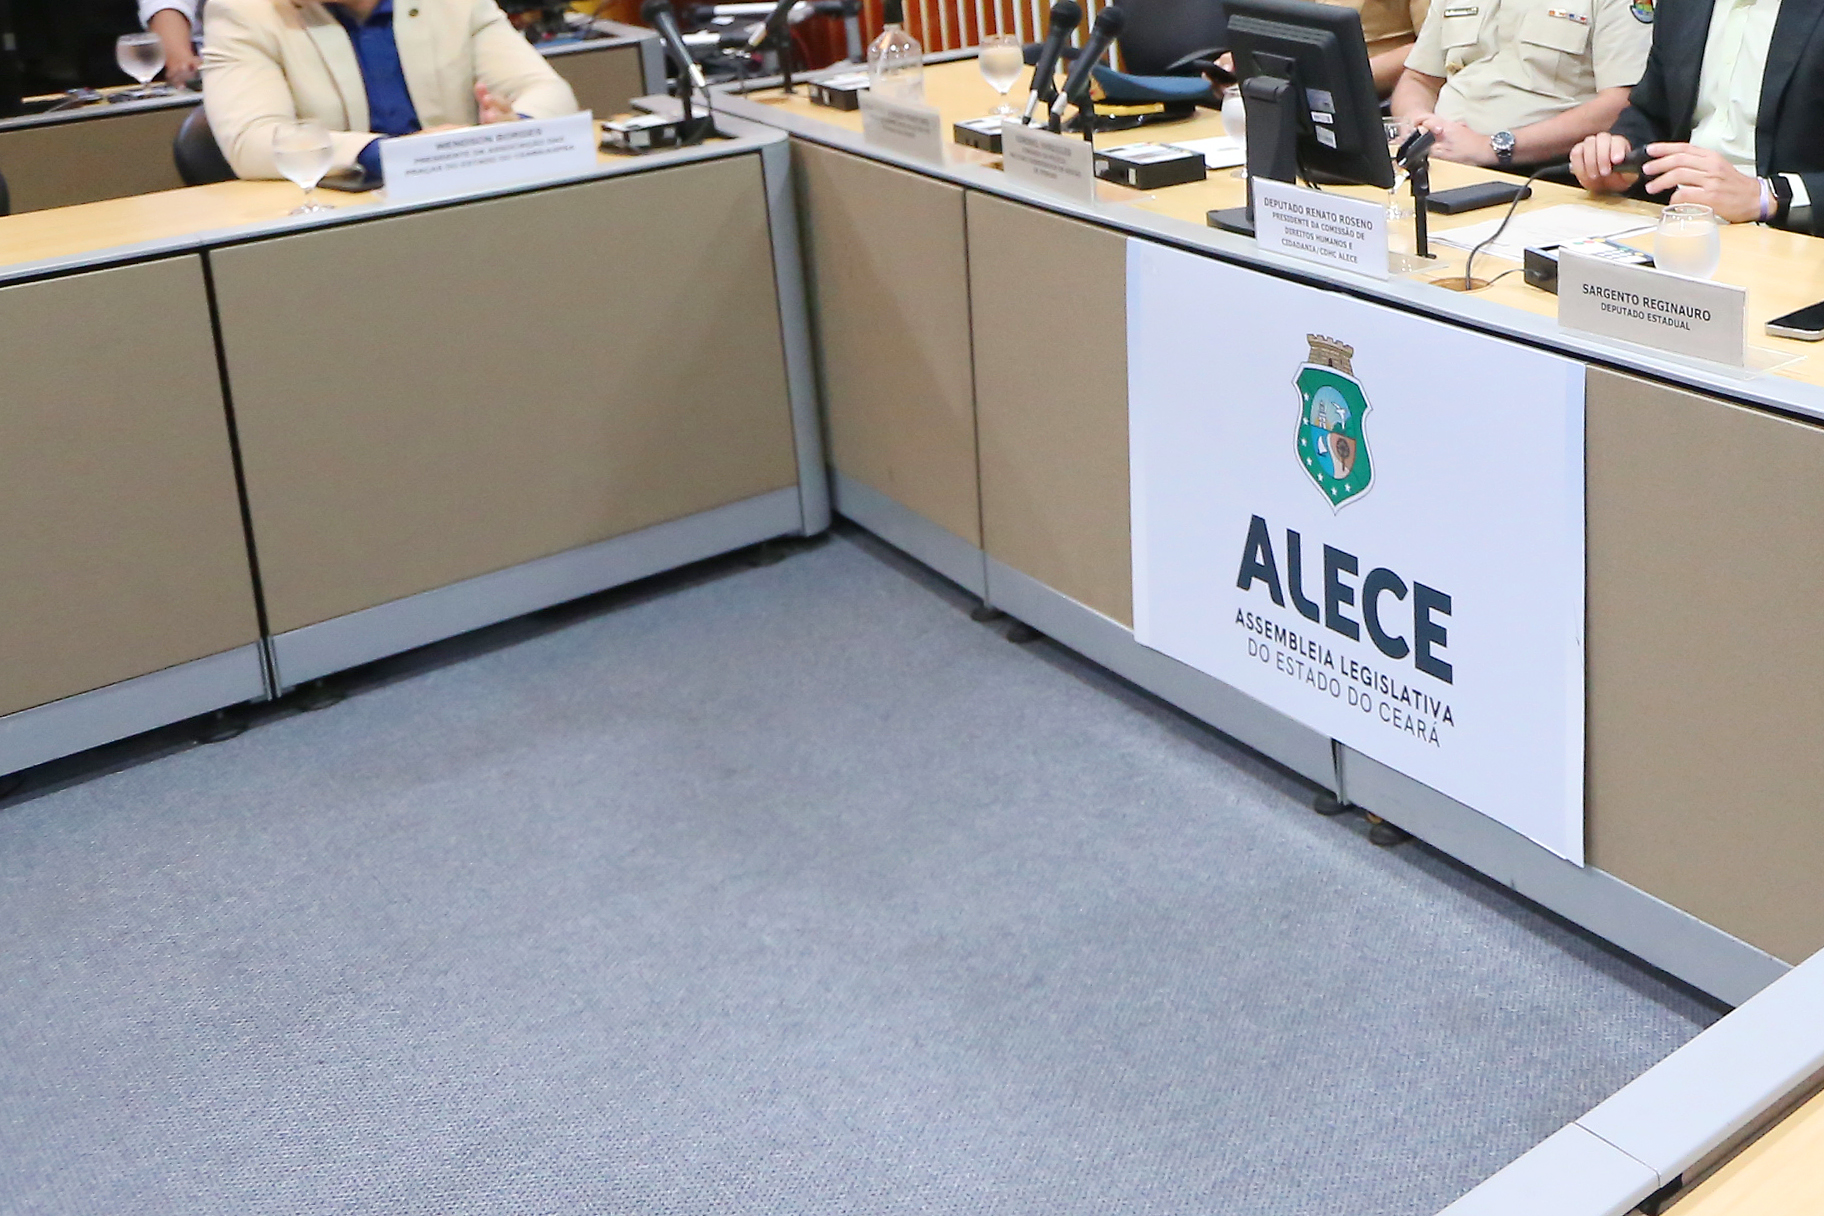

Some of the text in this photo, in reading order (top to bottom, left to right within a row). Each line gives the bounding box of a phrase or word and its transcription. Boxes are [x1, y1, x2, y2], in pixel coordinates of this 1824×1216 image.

[1264, 197, 1373, 230] DEPUTADO RENATO ROSENO
[1272, 211, 1365, 240] PRESIDENTE DA COMISSÃO DE
[1284, 227, 1314, 240] DIREITOS
[1316, 235, 1347, 248] HUMANOS
[1339, 253, 1358, 264] ALECE
[1582, 284, 1711, 322] SARGENTO REGINAURO
[1601, 302, 1691, 331] DEPUTADO ESTADUAL
[1236, 513, 1453, 685] ALECE
[1235, 608, 1455, 727] ASSEMBLEIA LEGISLATIVA
[1248, 637, 1441, 748] DO ESTADO DO CEARÁ
